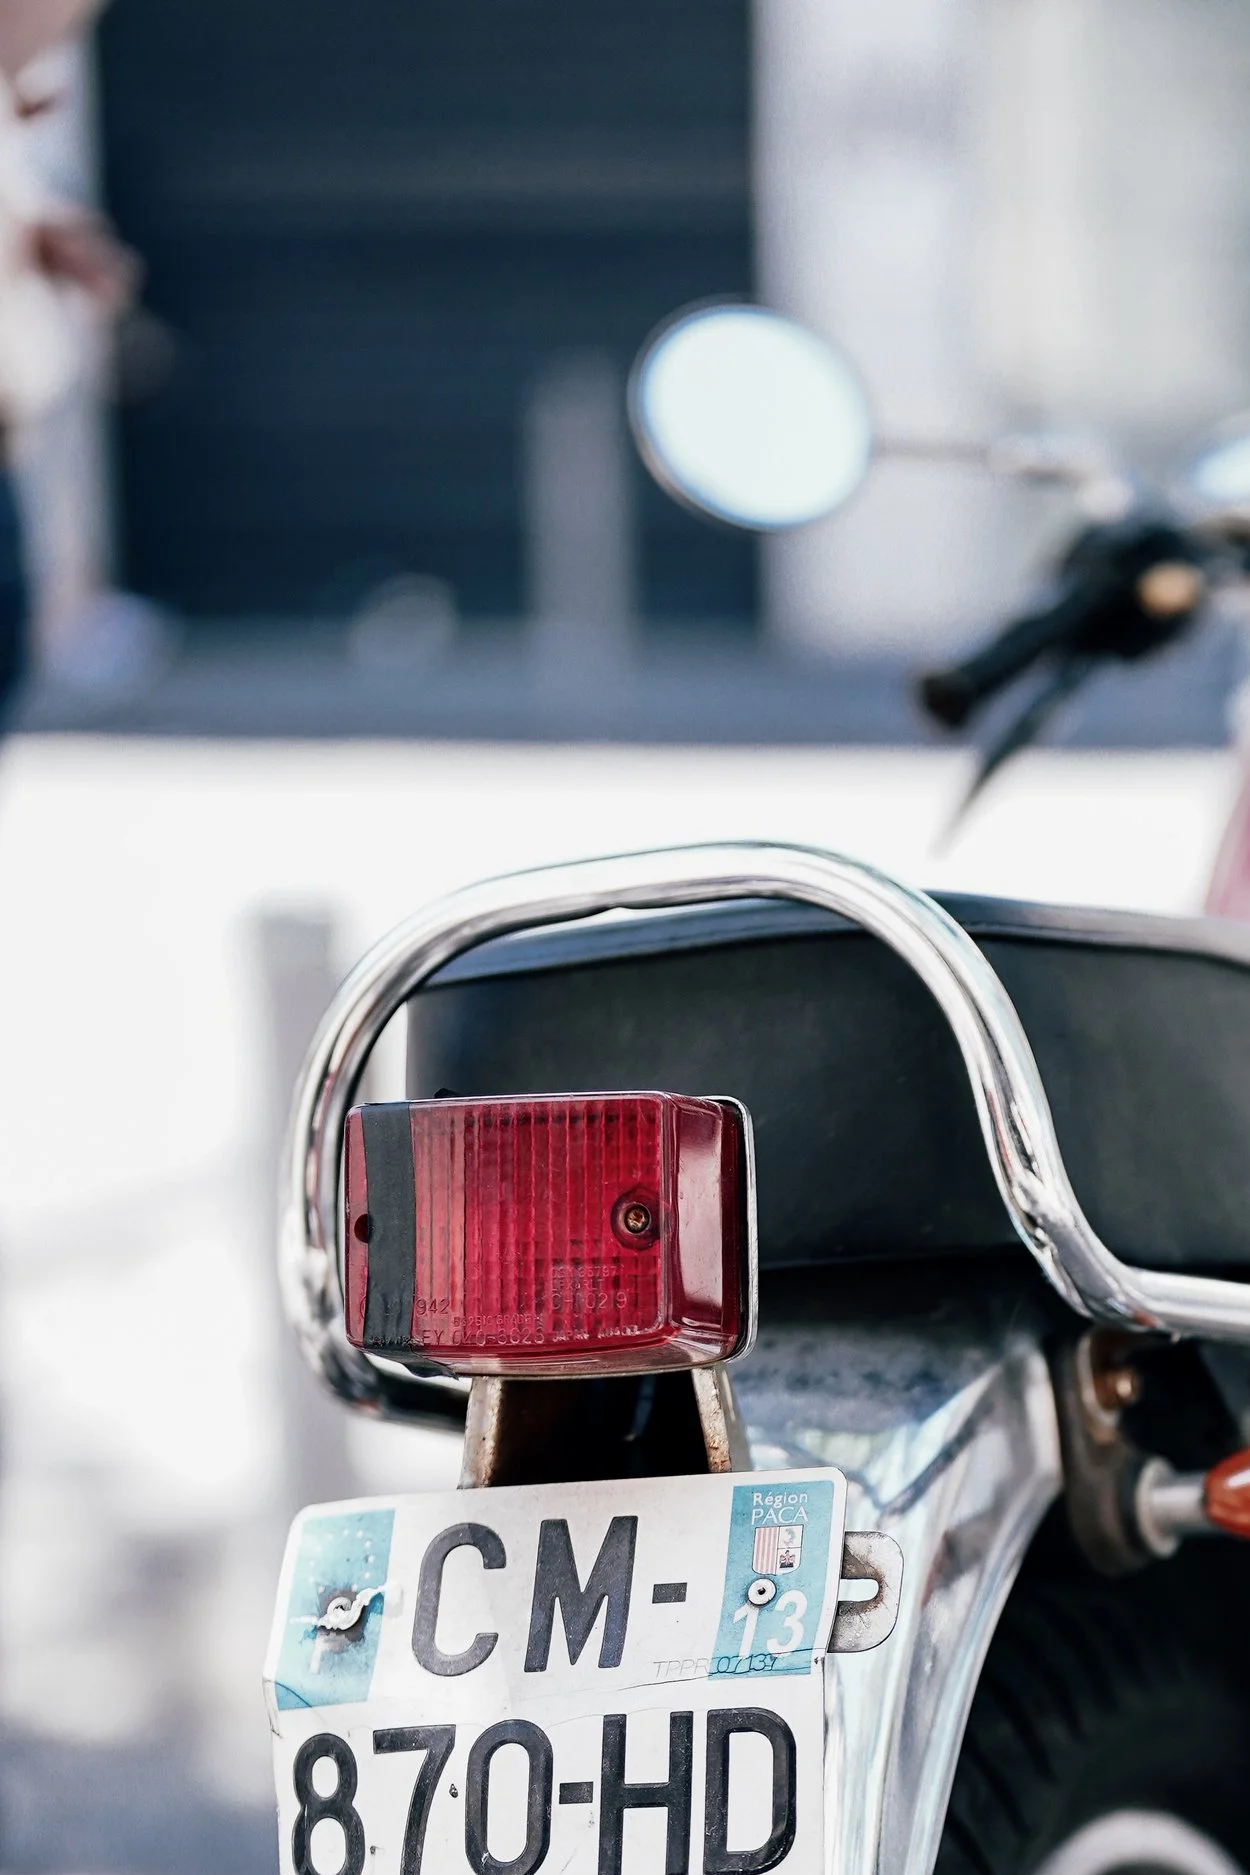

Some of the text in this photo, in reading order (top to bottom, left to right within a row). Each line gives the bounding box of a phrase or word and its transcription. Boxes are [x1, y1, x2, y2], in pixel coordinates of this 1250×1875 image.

[751, 1505, 808, 1525] PACA
[753, 1491, 808, 1508] Région
[411, 1515, 687, 1677] CM-
[732, 1590, 807, 1662] 13
